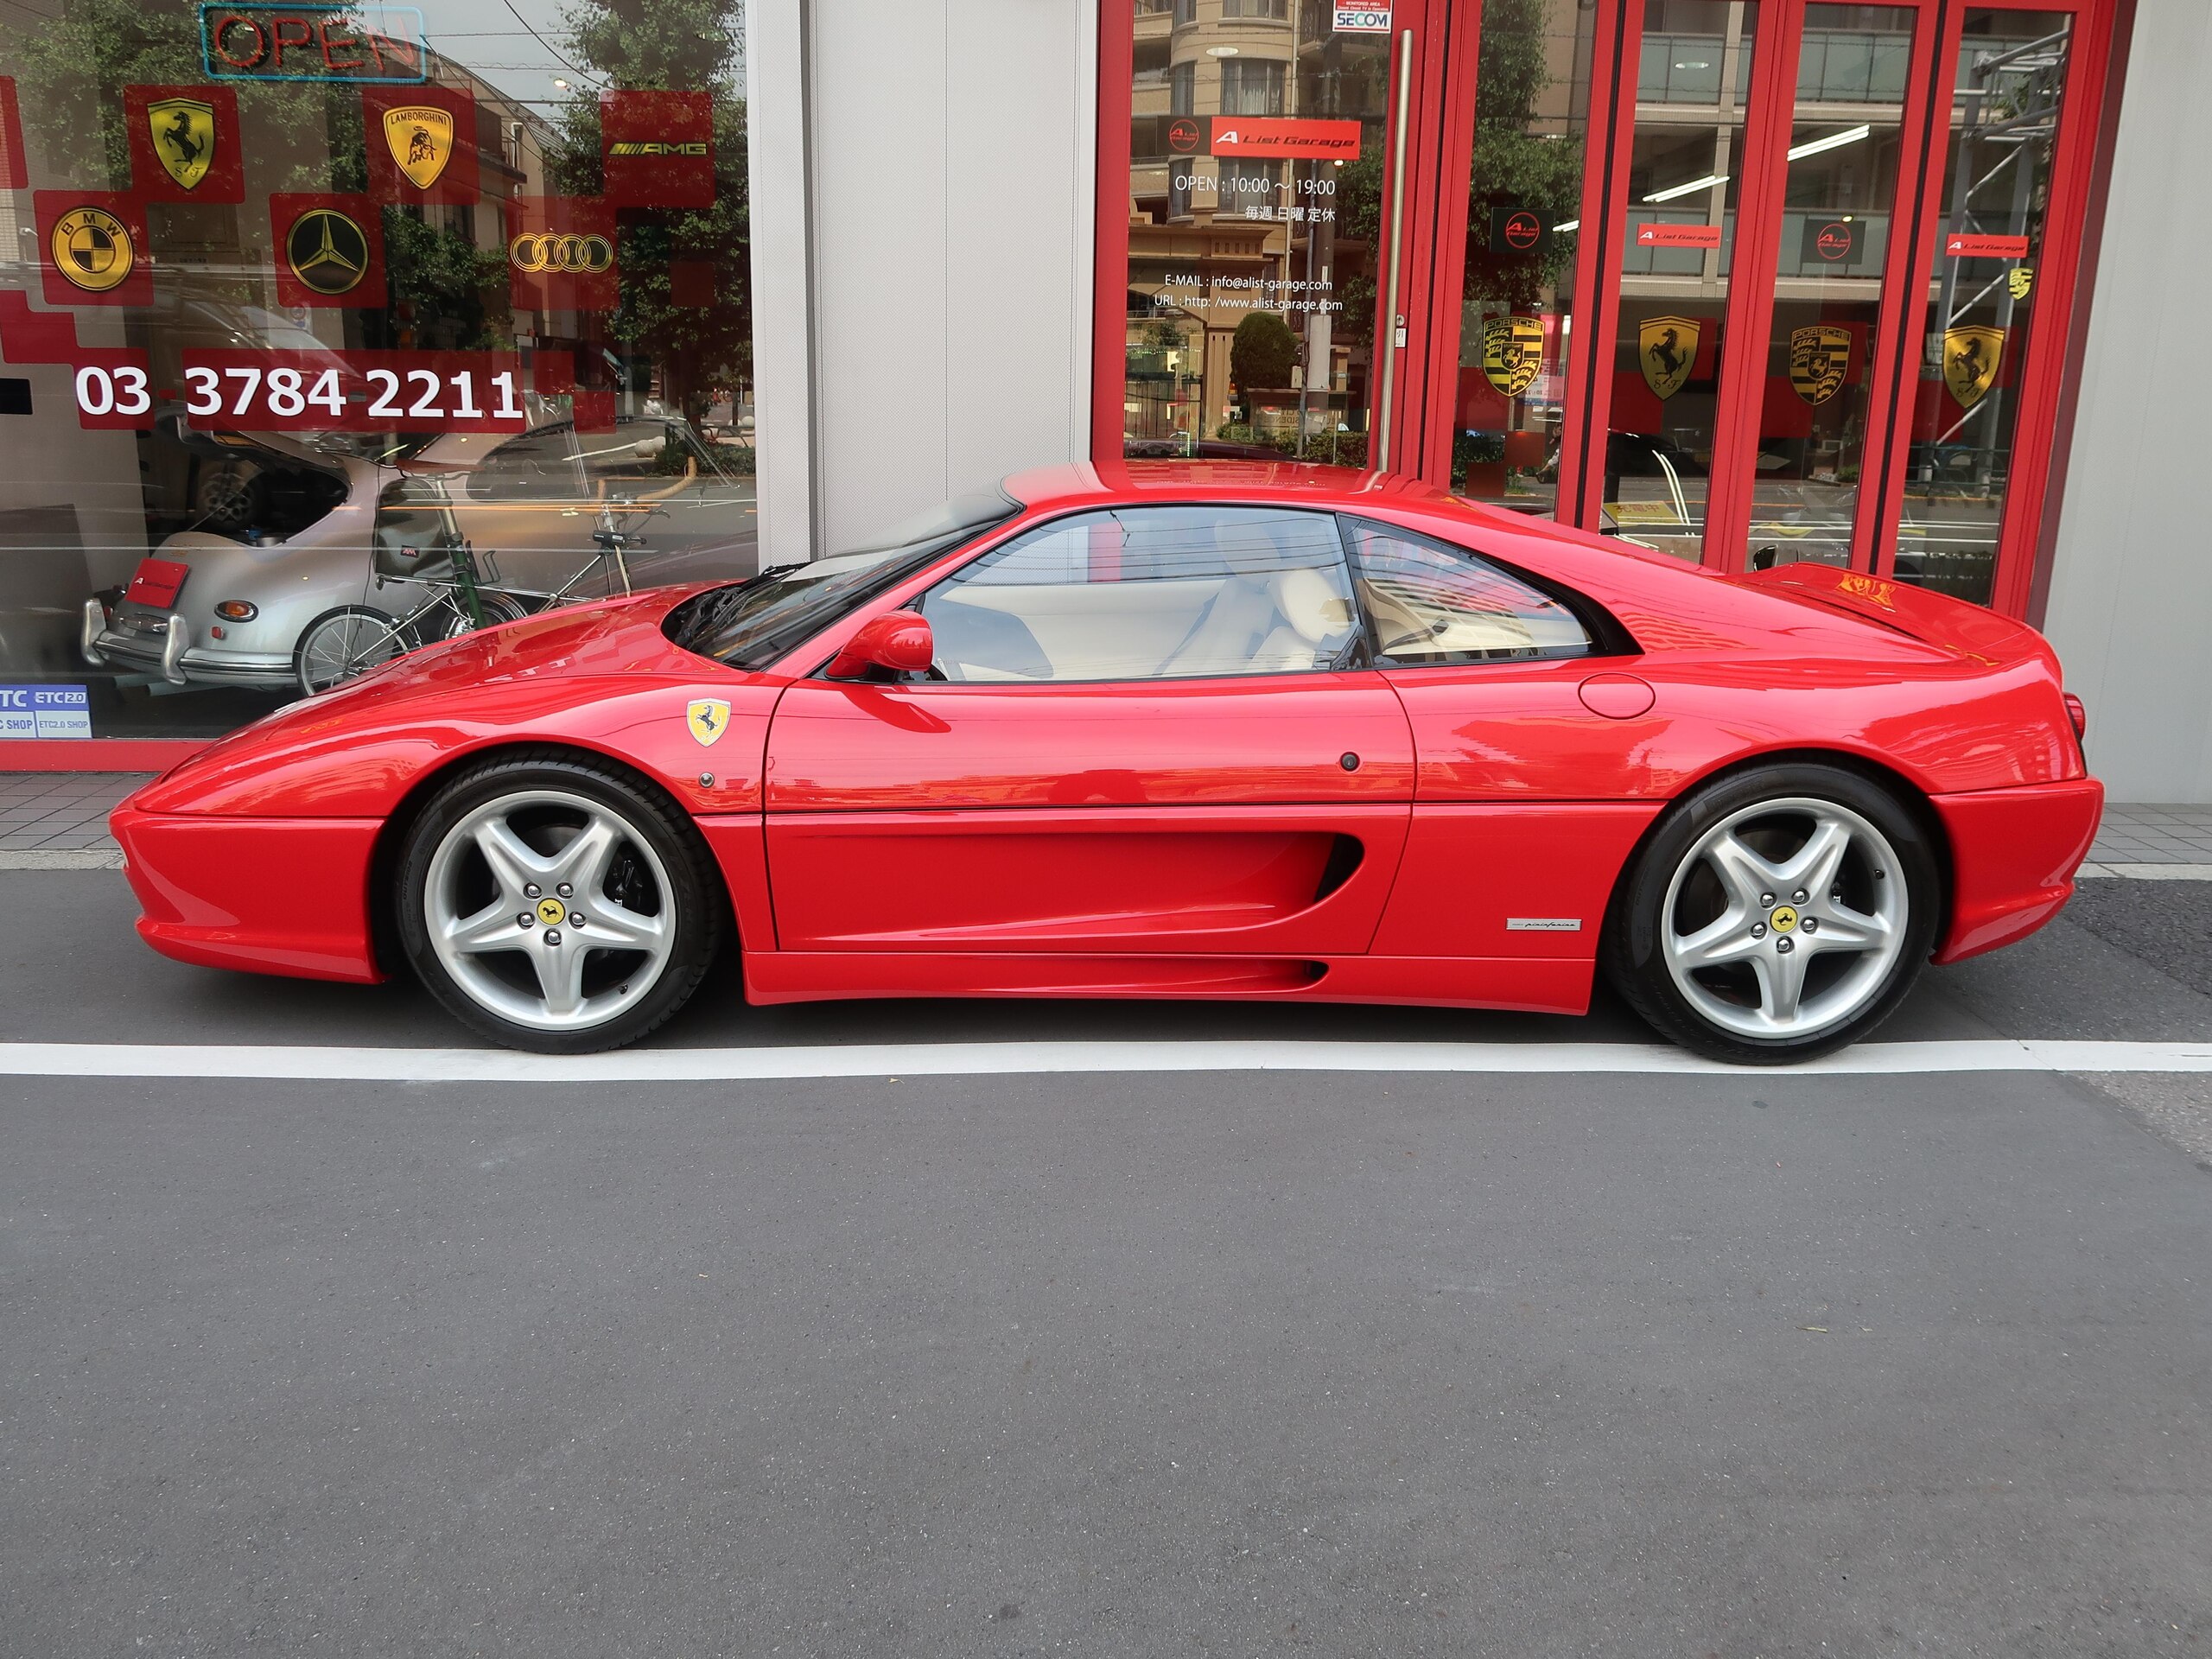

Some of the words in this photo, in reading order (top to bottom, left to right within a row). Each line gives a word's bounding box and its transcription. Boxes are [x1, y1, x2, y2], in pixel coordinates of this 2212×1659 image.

[1337, 12, 1388, 27] SECOM
[214, 15, 415, 72] OPEN
[391, 111, 447, 125] LAMBORGHINI
[1216, 130, 1238, 144] A
[1243, 135, 1281, 144] List
[1283, 137, 1355, 148] Garage
[639, 143, 707, 155] AMG
[1174, 175, 1217, 192] OPEN
[1230, 177, 1270, 194] 10:00
[1296, 179, 1336, 195] 19:00
[1244, 205, 1273, 220] 毎週
[1277, 207, 1304, 221] 日曜
[1307, 207, 1336, 223] 定休
[60, 213, 121, 237] BMW
[1165, 274, 1203, 286] E-MAIL
[1211, 276, 1332, 291] info@alist-garage.com
[1154, 295, 1176, 306] URL
[1485, 318, 1542, 331] PORSCHE
[1793, 328, 1849, 340] PORSCHE
[75, 366, 151, 416] 03
[184, 367, 347, 416] 3784
[365, 369, 524, 418] 2211
[0, 690, 27, 707] TC
[7, 720, 33, 730] SHOP
